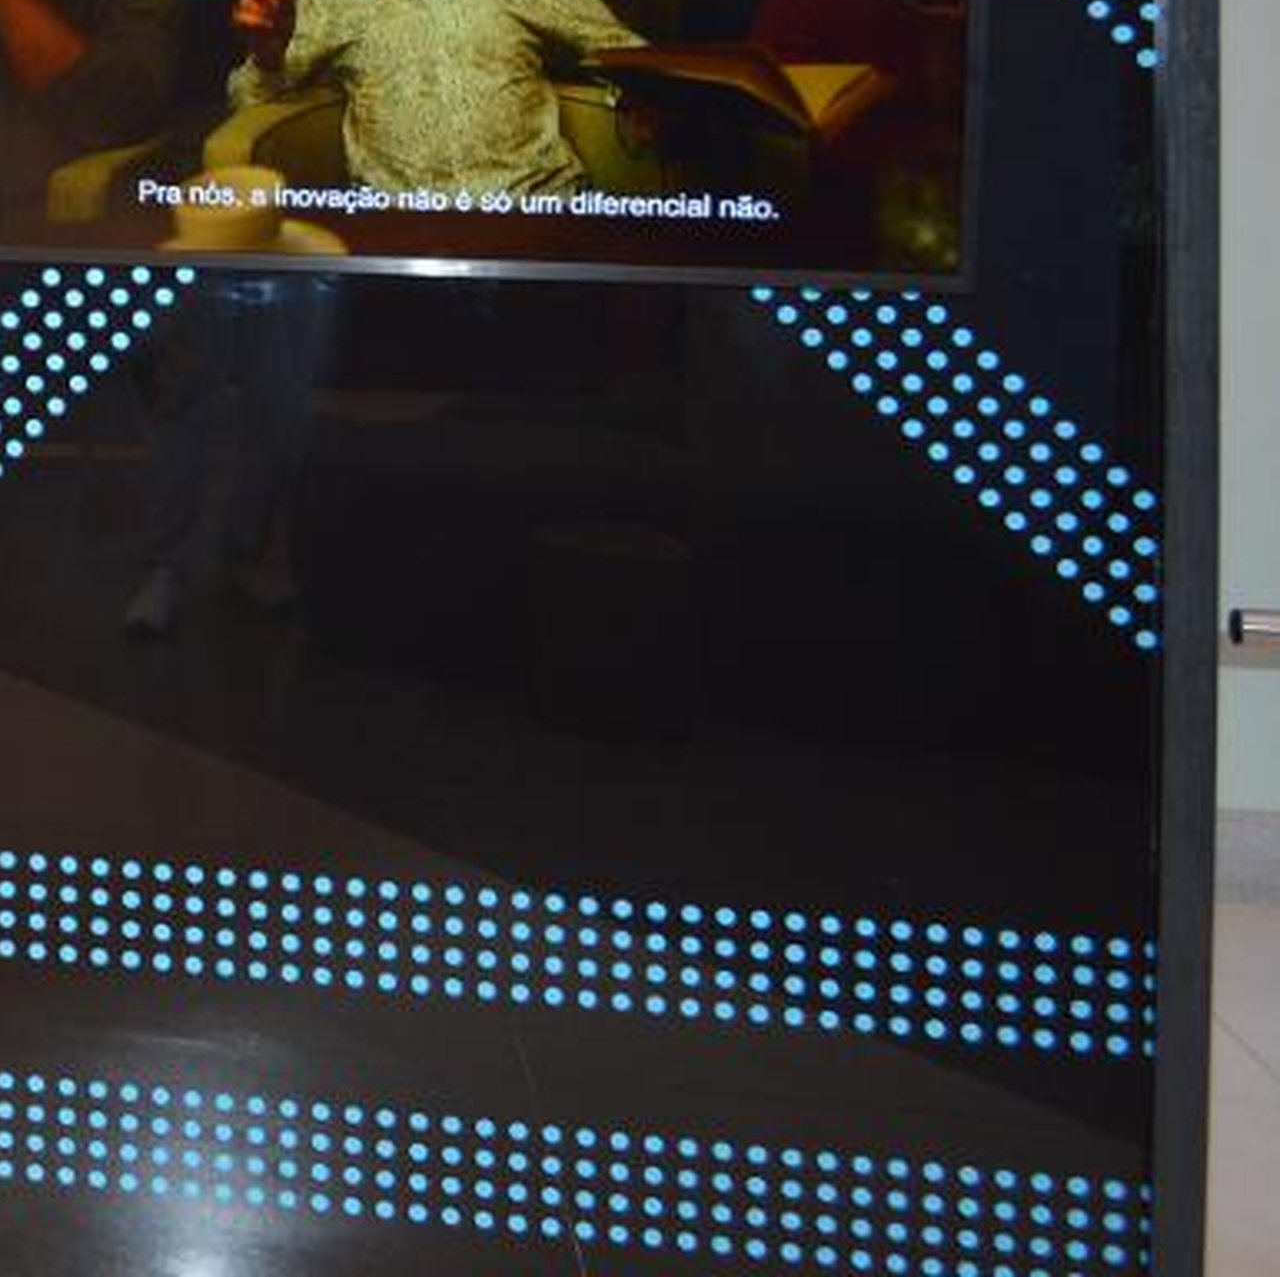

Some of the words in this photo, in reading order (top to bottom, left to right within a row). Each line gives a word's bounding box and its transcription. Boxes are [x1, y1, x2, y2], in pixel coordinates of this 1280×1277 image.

[138, 179, 182, 205] Pra
[251, 186, 267, 206] a
[398, 184, 448, 211] não
[455, 187, 472, 211] é
[480, 188, 512, 213] só
[521, 194, 562, 214] um
[570, 191, 711, 218] diferencial
[719, 194, 780, 220] não.
